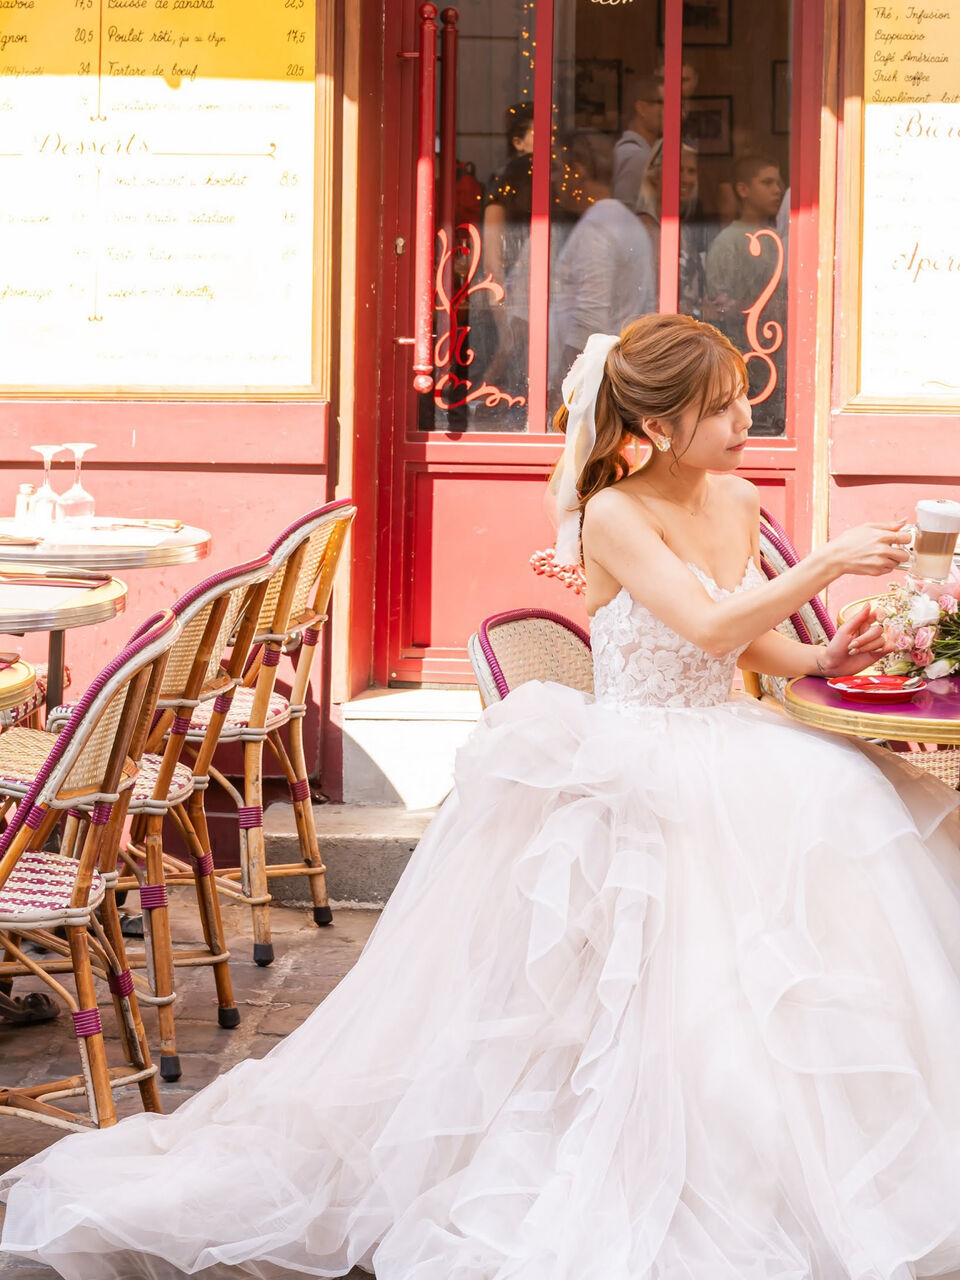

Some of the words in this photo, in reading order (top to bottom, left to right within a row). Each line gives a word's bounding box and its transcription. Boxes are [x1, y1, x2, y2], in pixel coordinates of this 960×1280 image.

[905, 6, 950, 24] Infusion
[108, 26, 144, 42] Poulet
[873, 50, 896, 67] Café
[900, 51, 950, 63] Américain
[108, 61, 146, 76] Tartare
